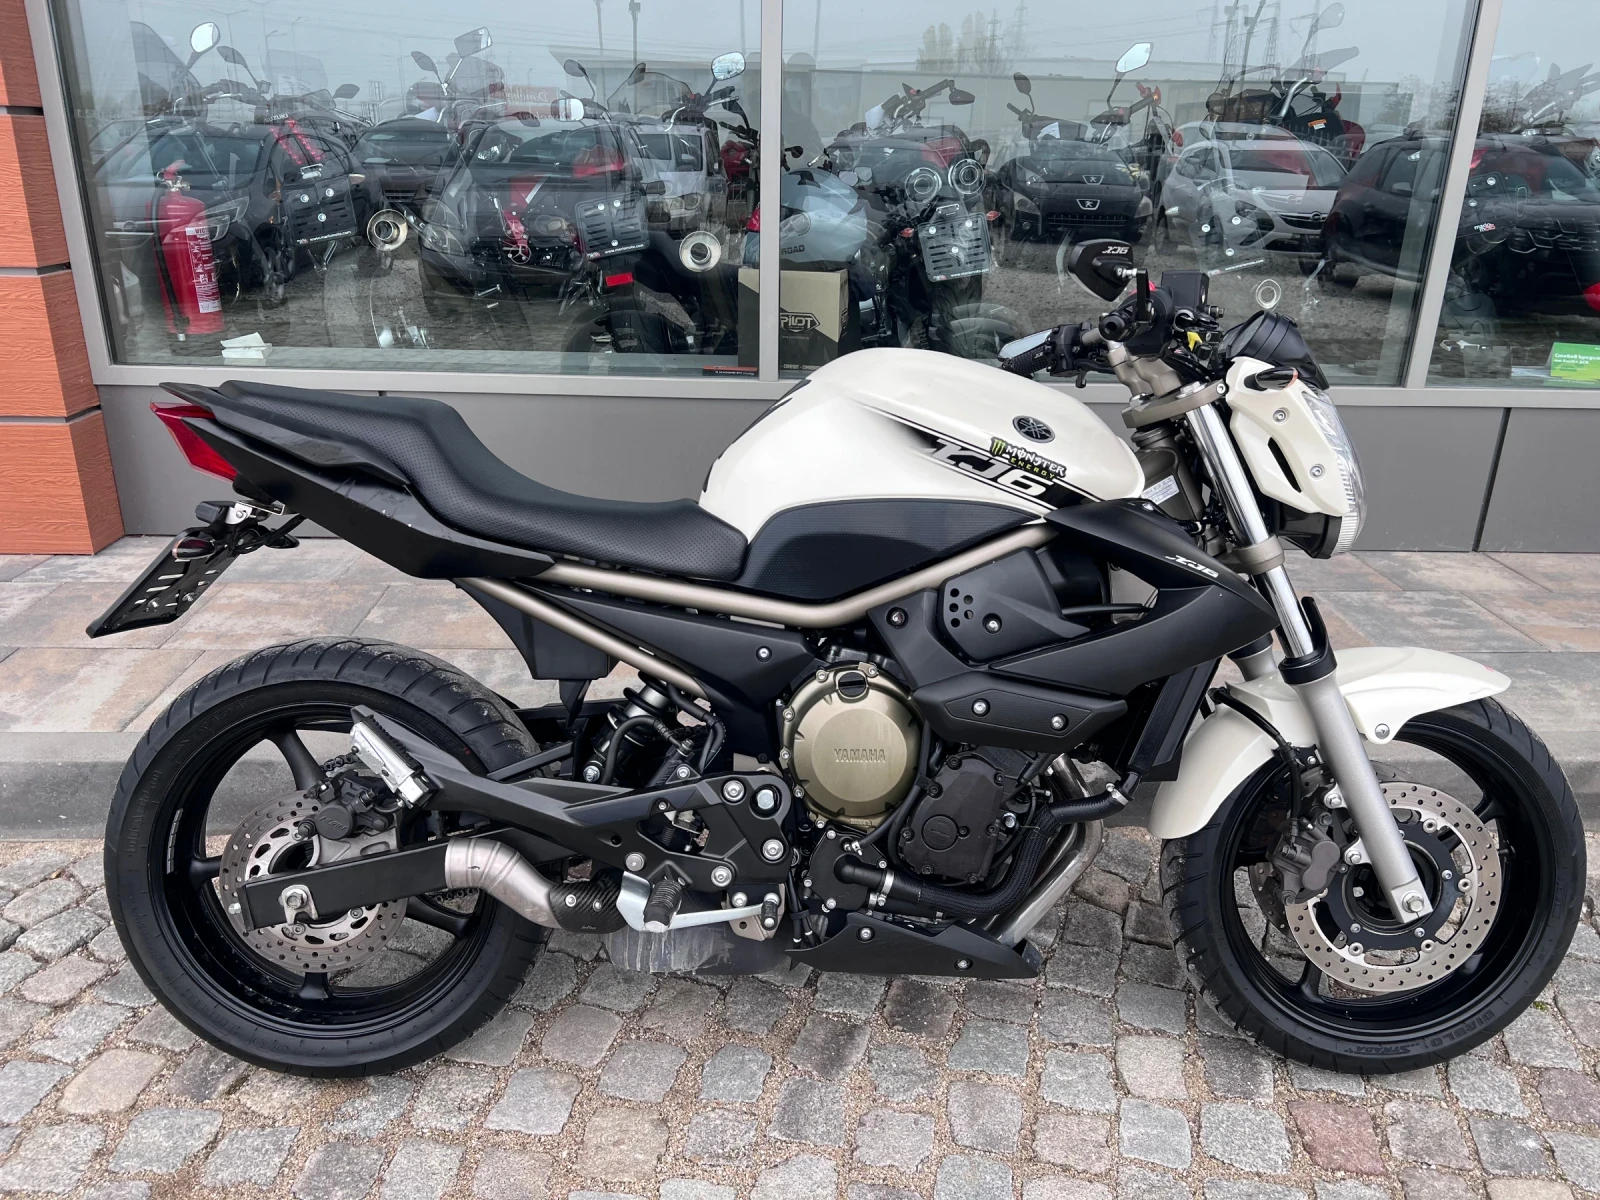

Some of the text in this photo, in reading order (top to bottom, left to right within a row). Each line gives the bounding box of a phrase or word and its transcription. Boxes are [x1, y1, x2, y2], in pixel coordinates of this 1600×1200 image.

[1101, 245, 1130, 255] XJ6
[931, 437, 1054, 497] XJ6
[1006, 444, 1066, 477] MONSTER
[1010, 457, 1055, 479] ENERGY
[1164, 554, 1219, 578] XJ6
[833, 748, 886, 763] YAMAHA
[1430, 1009, 1496, 1048] DIABLO
